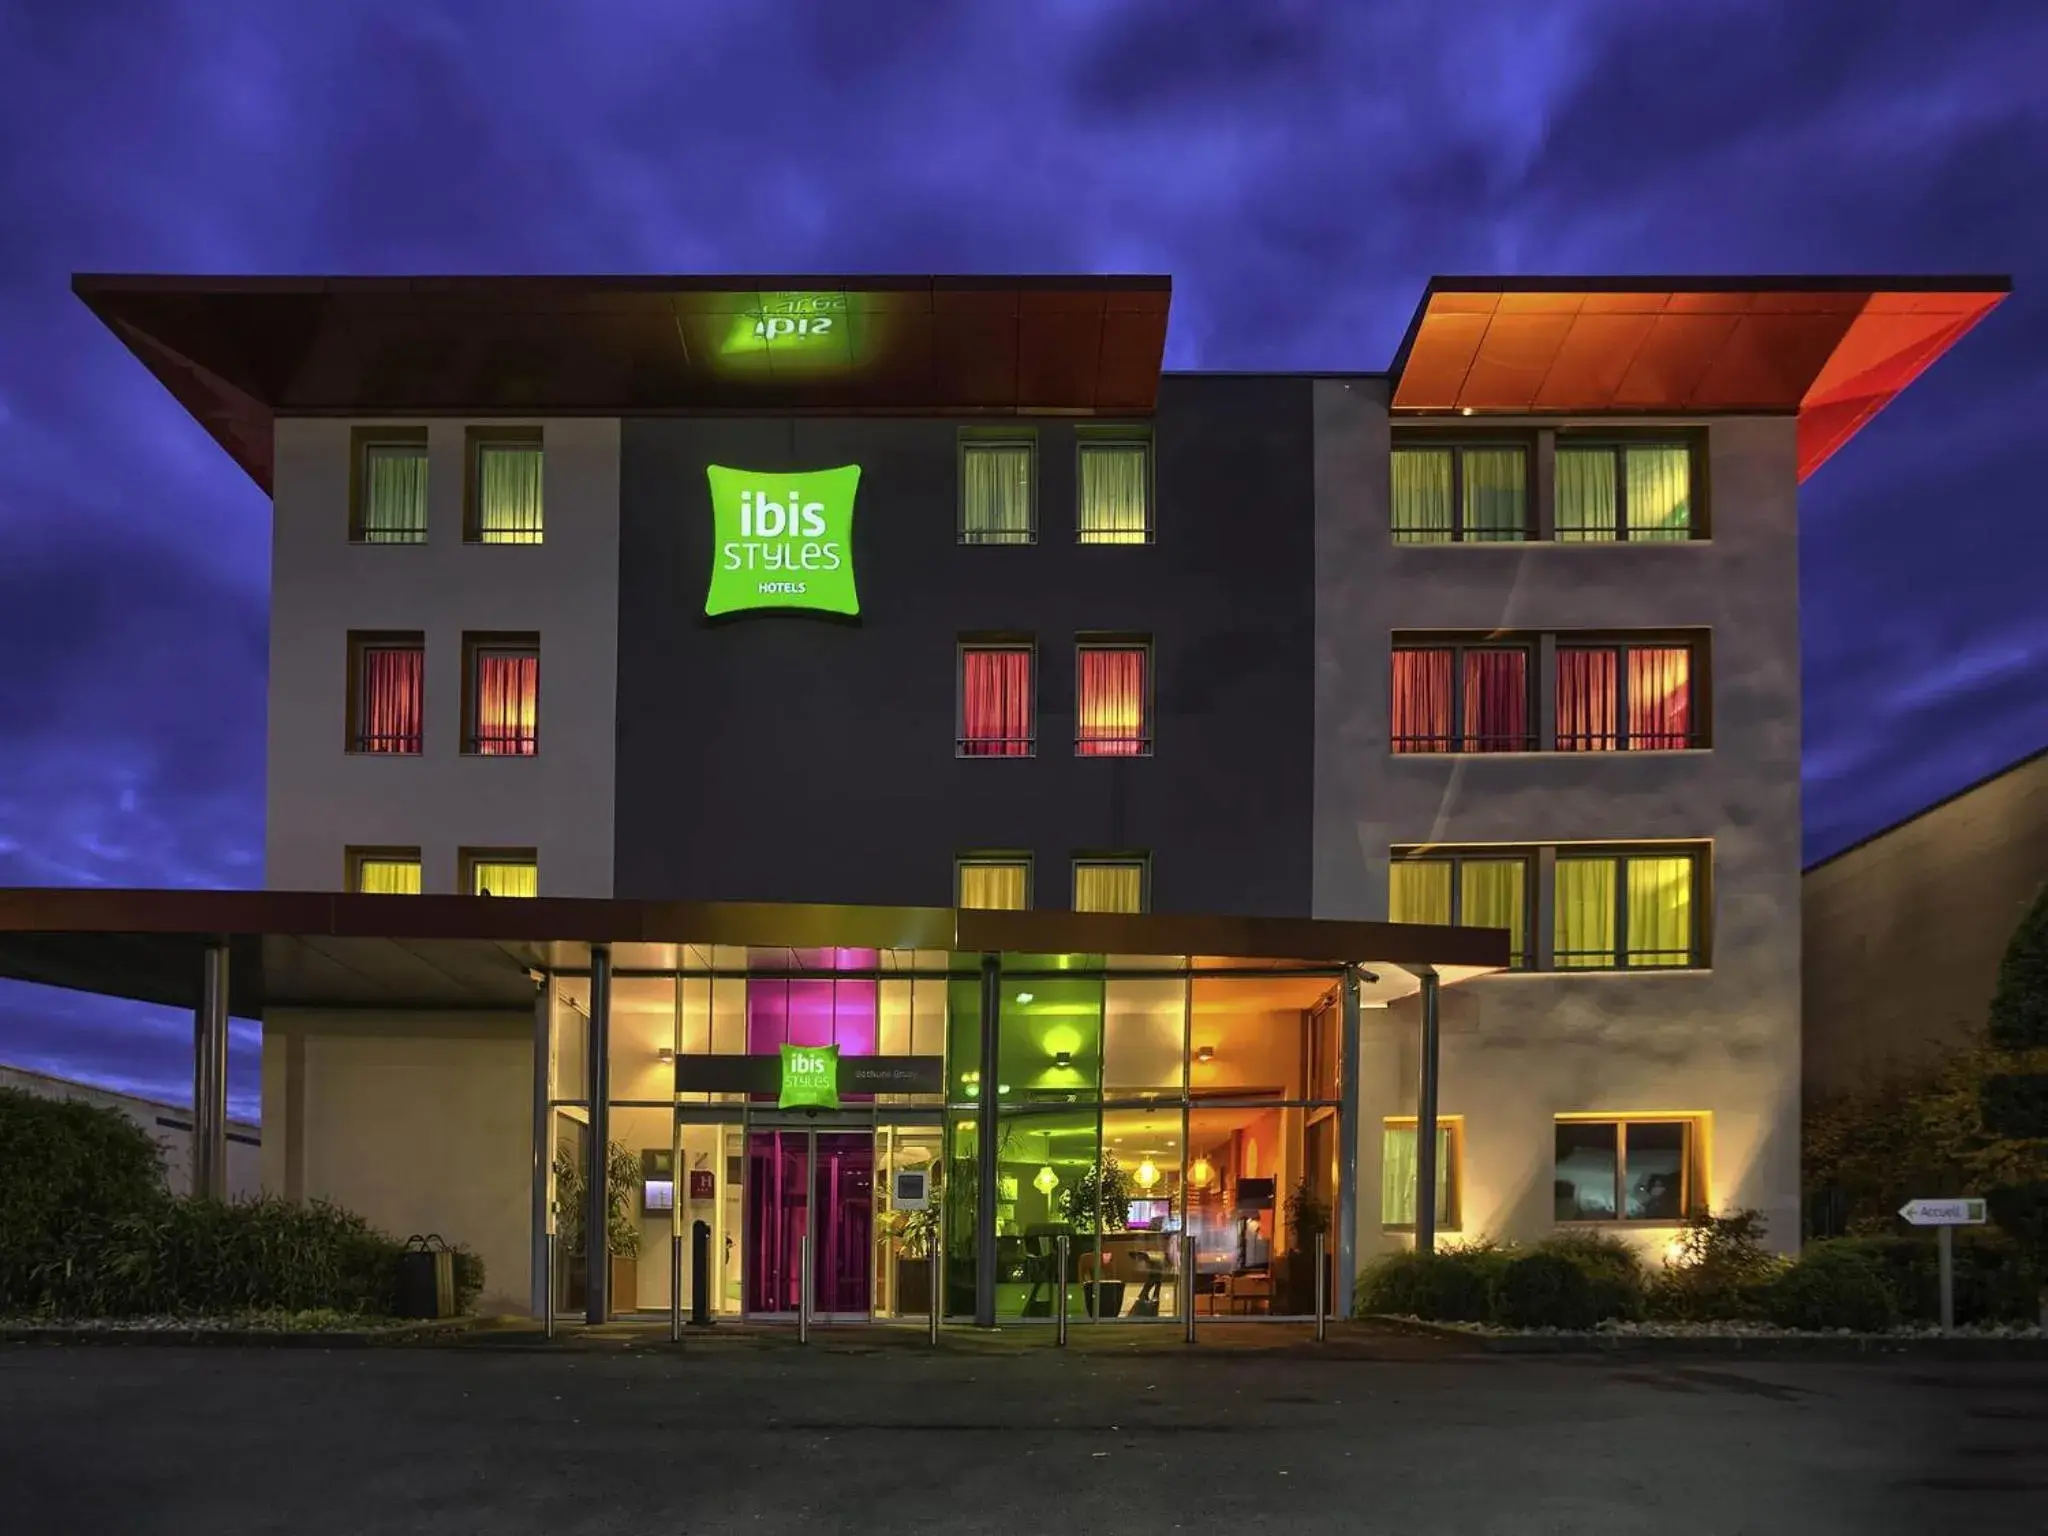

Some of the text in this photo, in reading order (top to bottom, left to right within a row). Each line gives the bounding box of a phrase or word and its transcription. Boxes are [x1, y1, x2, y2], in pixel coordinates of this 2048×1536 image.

[740, 491, 827, 538] ibis
[758, 582, 806, 594] HOTELS
[791, 1053, 825, 1073] ibis
